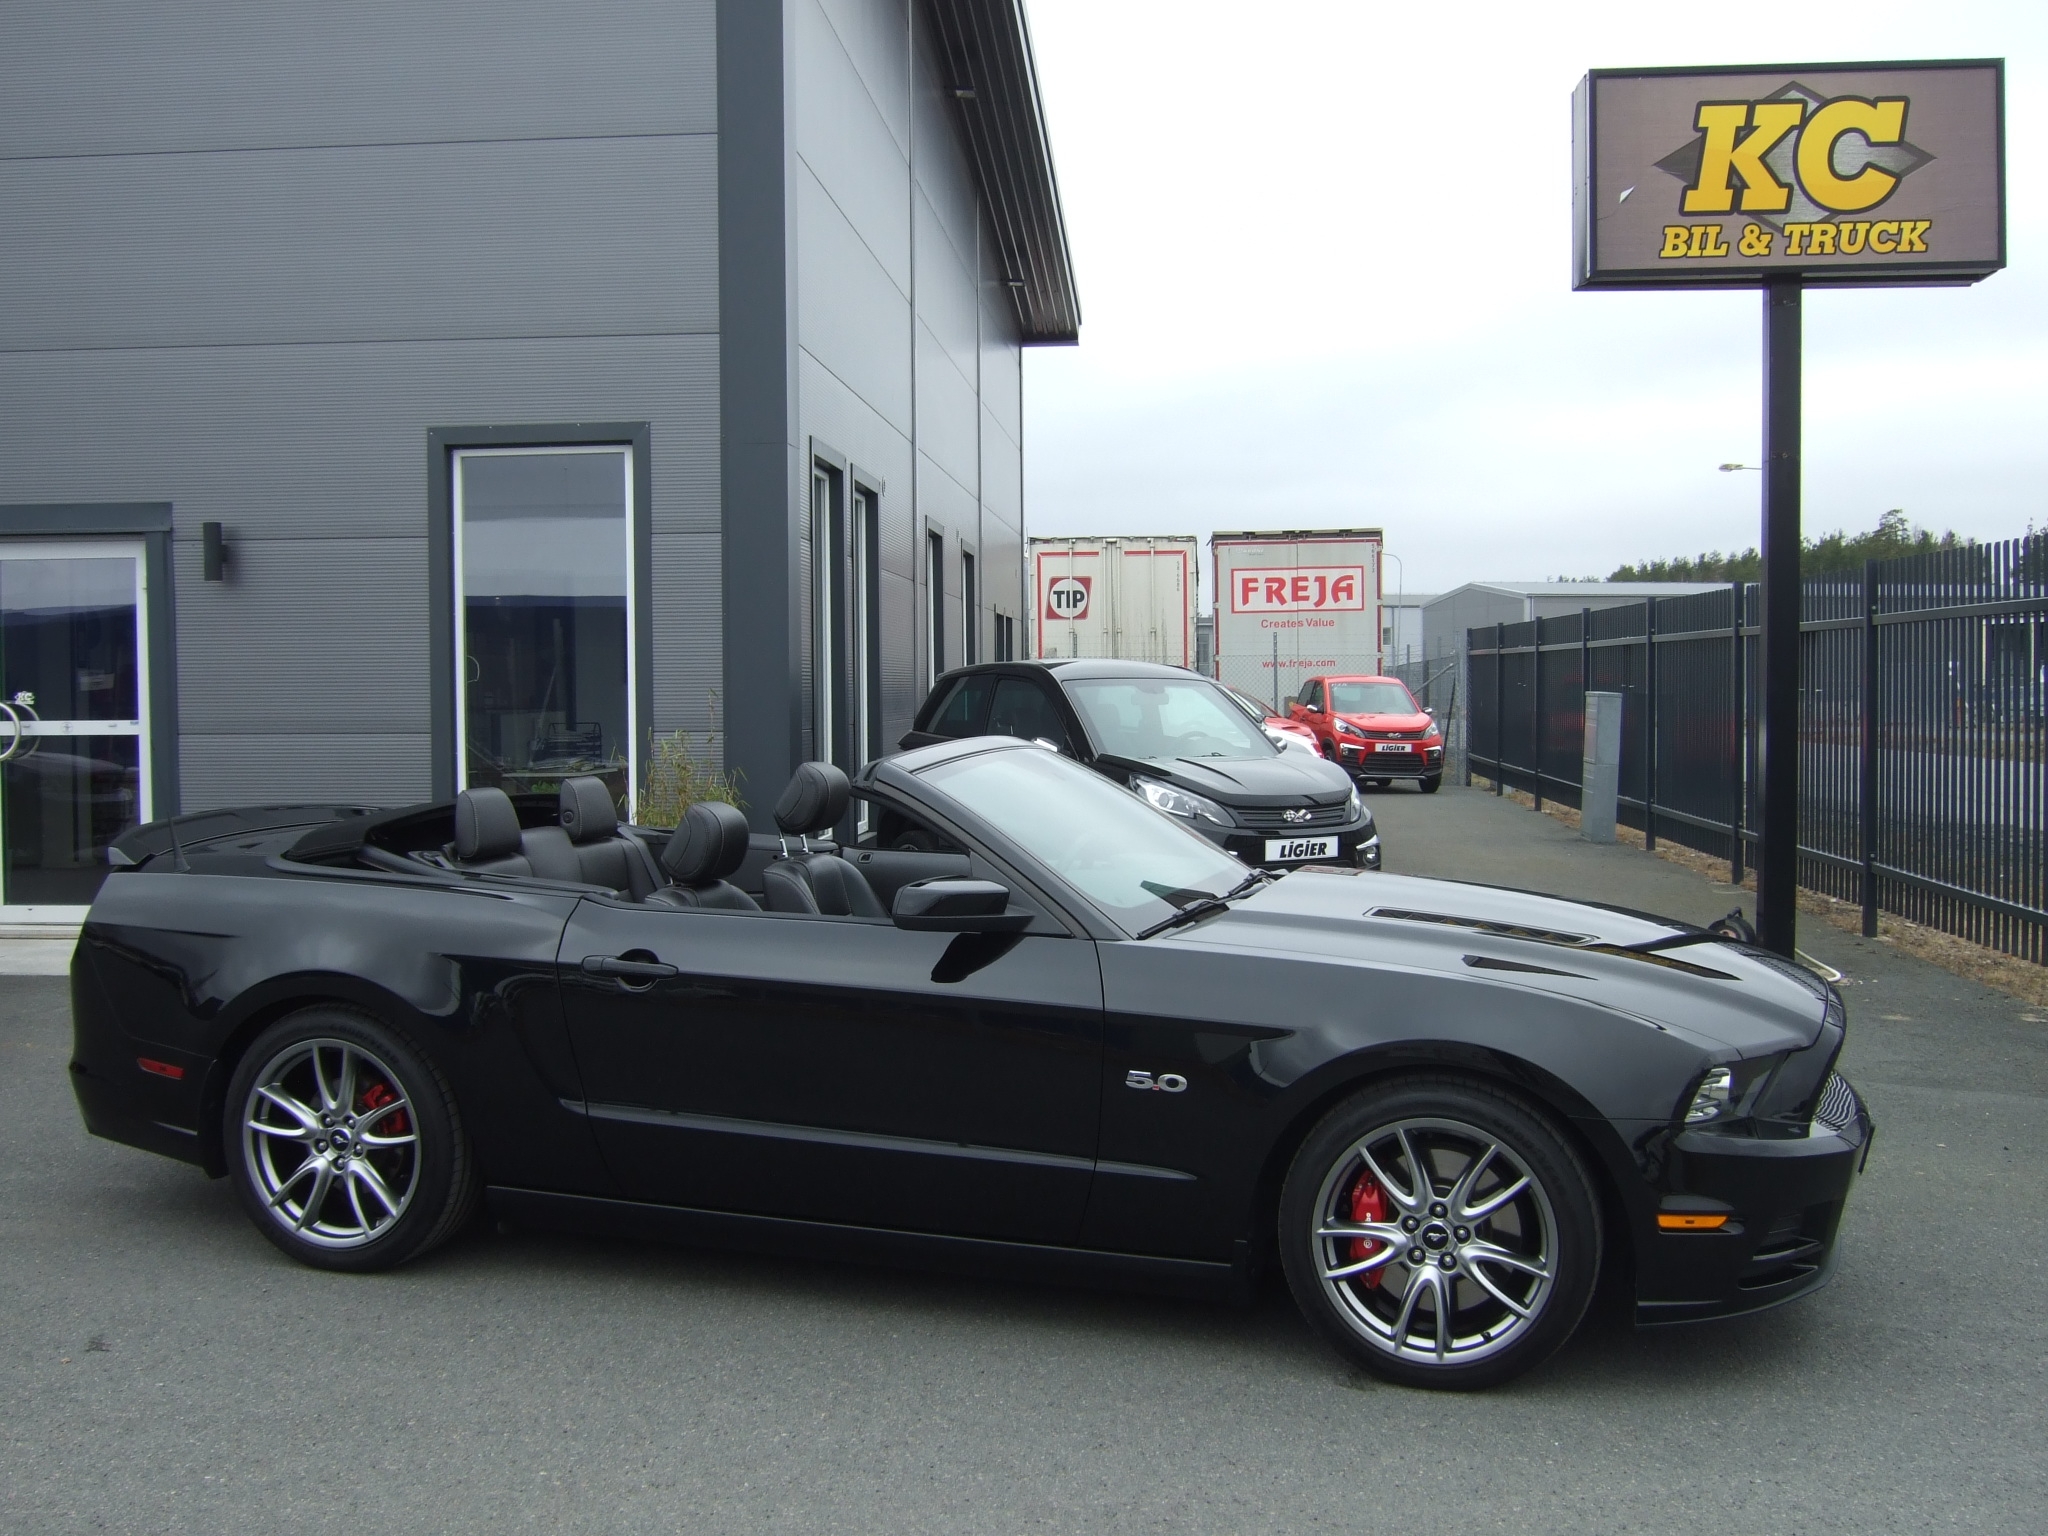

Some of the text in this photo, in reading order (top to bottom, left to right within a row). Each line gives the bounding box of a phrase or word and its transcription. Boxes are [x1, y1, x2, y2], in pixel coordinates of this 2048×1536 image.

[1683, 99, 1906, 212] KC
[1659, 220, 1931, 258] BIL & TRUCK
[1053, 590, 1085, 609] TIP
[1240, 574, 1355, 608] FREJA
[1260, 617, 1335, 629] Creates Value
[1261, 658, 1337, 669] www.freja.com
[1125, 1070, 1188, 1093] 5.0
